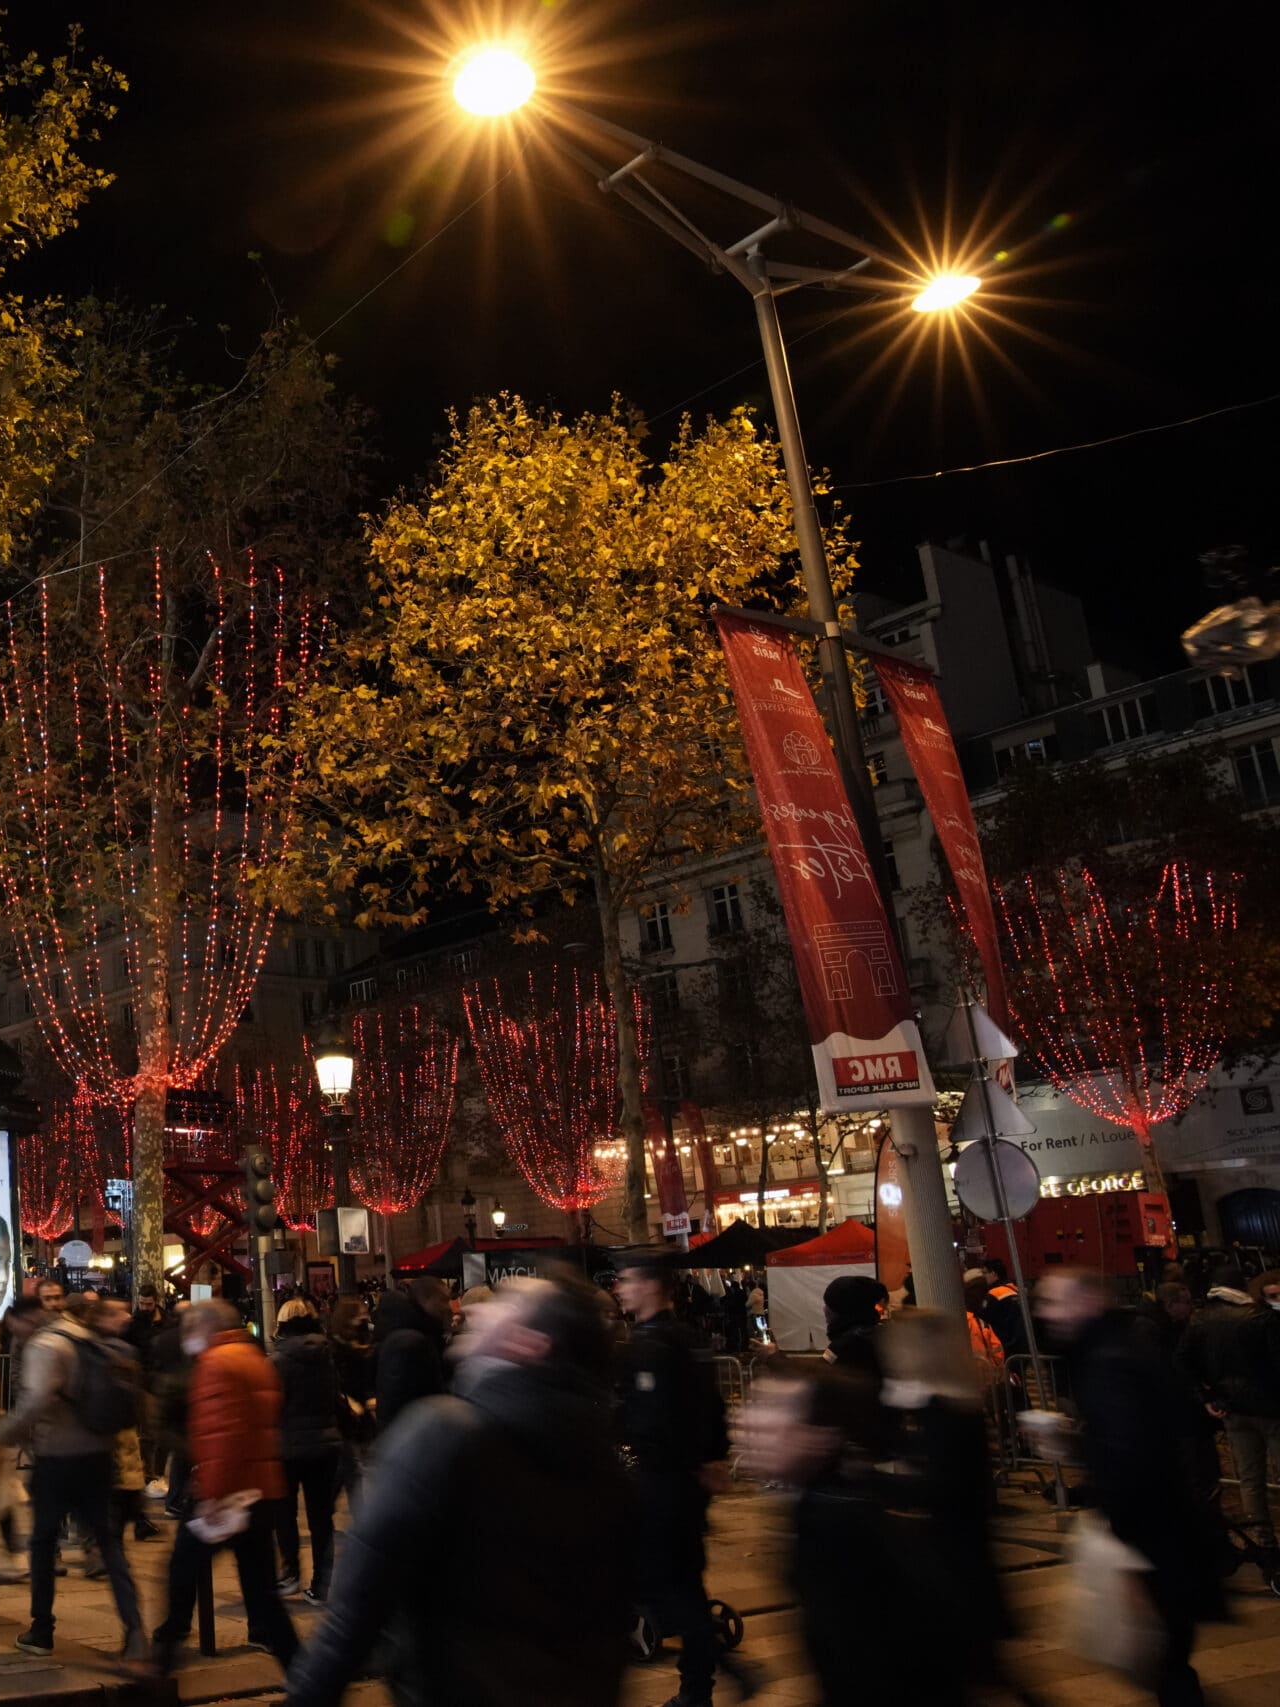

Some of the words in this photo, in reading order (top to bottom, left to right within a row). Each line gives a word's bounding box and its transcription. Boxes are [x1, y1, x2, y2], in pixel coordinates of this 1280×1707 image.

[1021, 1141, 1042, 1152] For
[1045, 1135, 1077, 1149] Rent
[1089, 1134, 1099, 1144] A
[1102, 1129, 1137, 1143] Loue
[488, 1266, 537, 1283] MATCH
